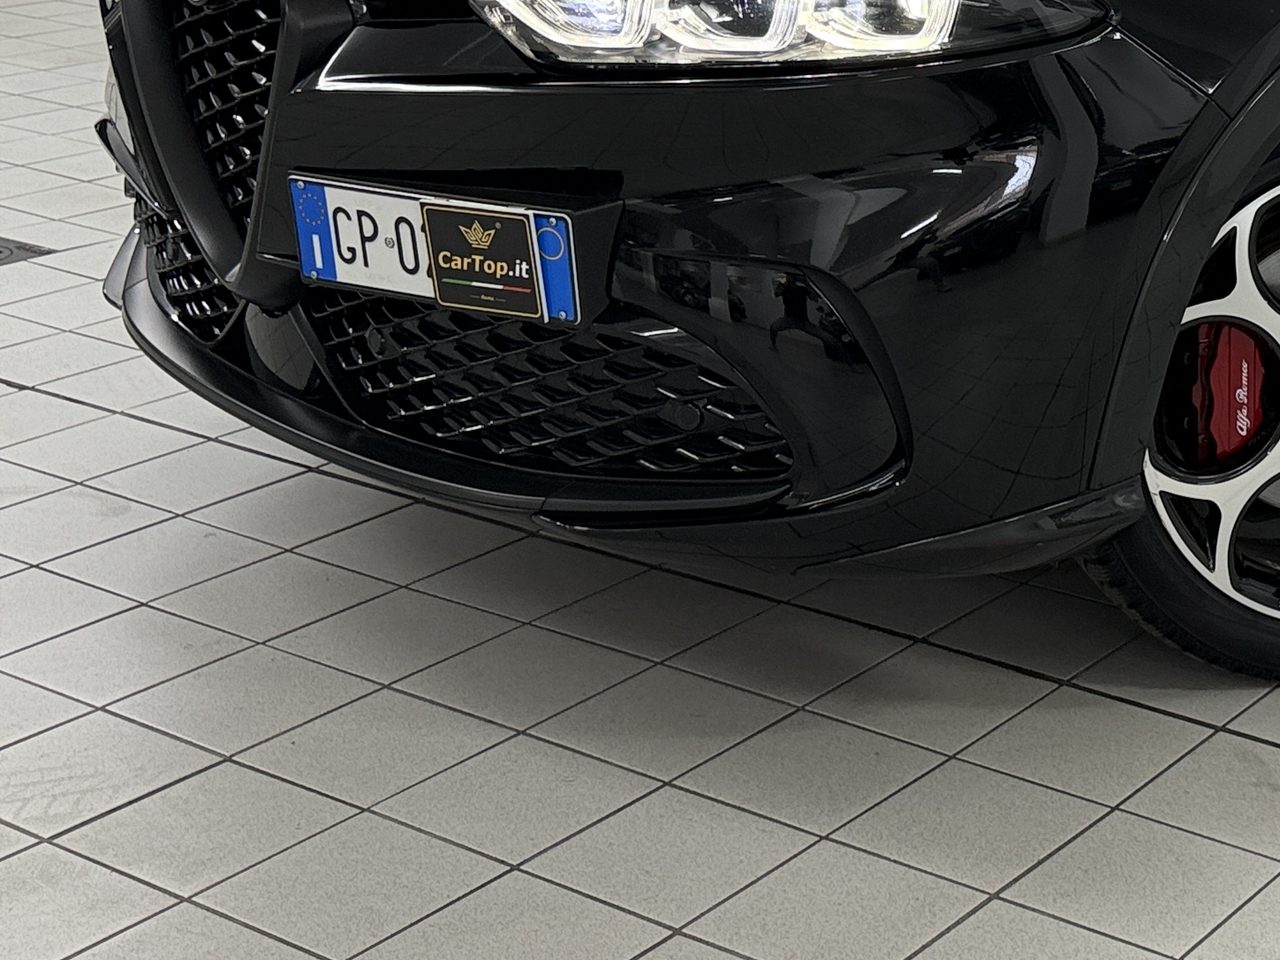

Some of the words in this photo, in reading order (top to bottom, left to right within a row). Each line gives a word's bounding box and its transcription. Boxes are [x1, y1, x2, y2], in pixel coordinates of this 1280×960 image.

[312, 234, 323, 269] I
[332, 206, 379, 268] GP
[394, 216, 432, 278] 0
[438, 250, 530, 279] CarTop.it
[1235, 359, 1249, 404] Romeo
[1236, 405, 1250, 436] Alfa
